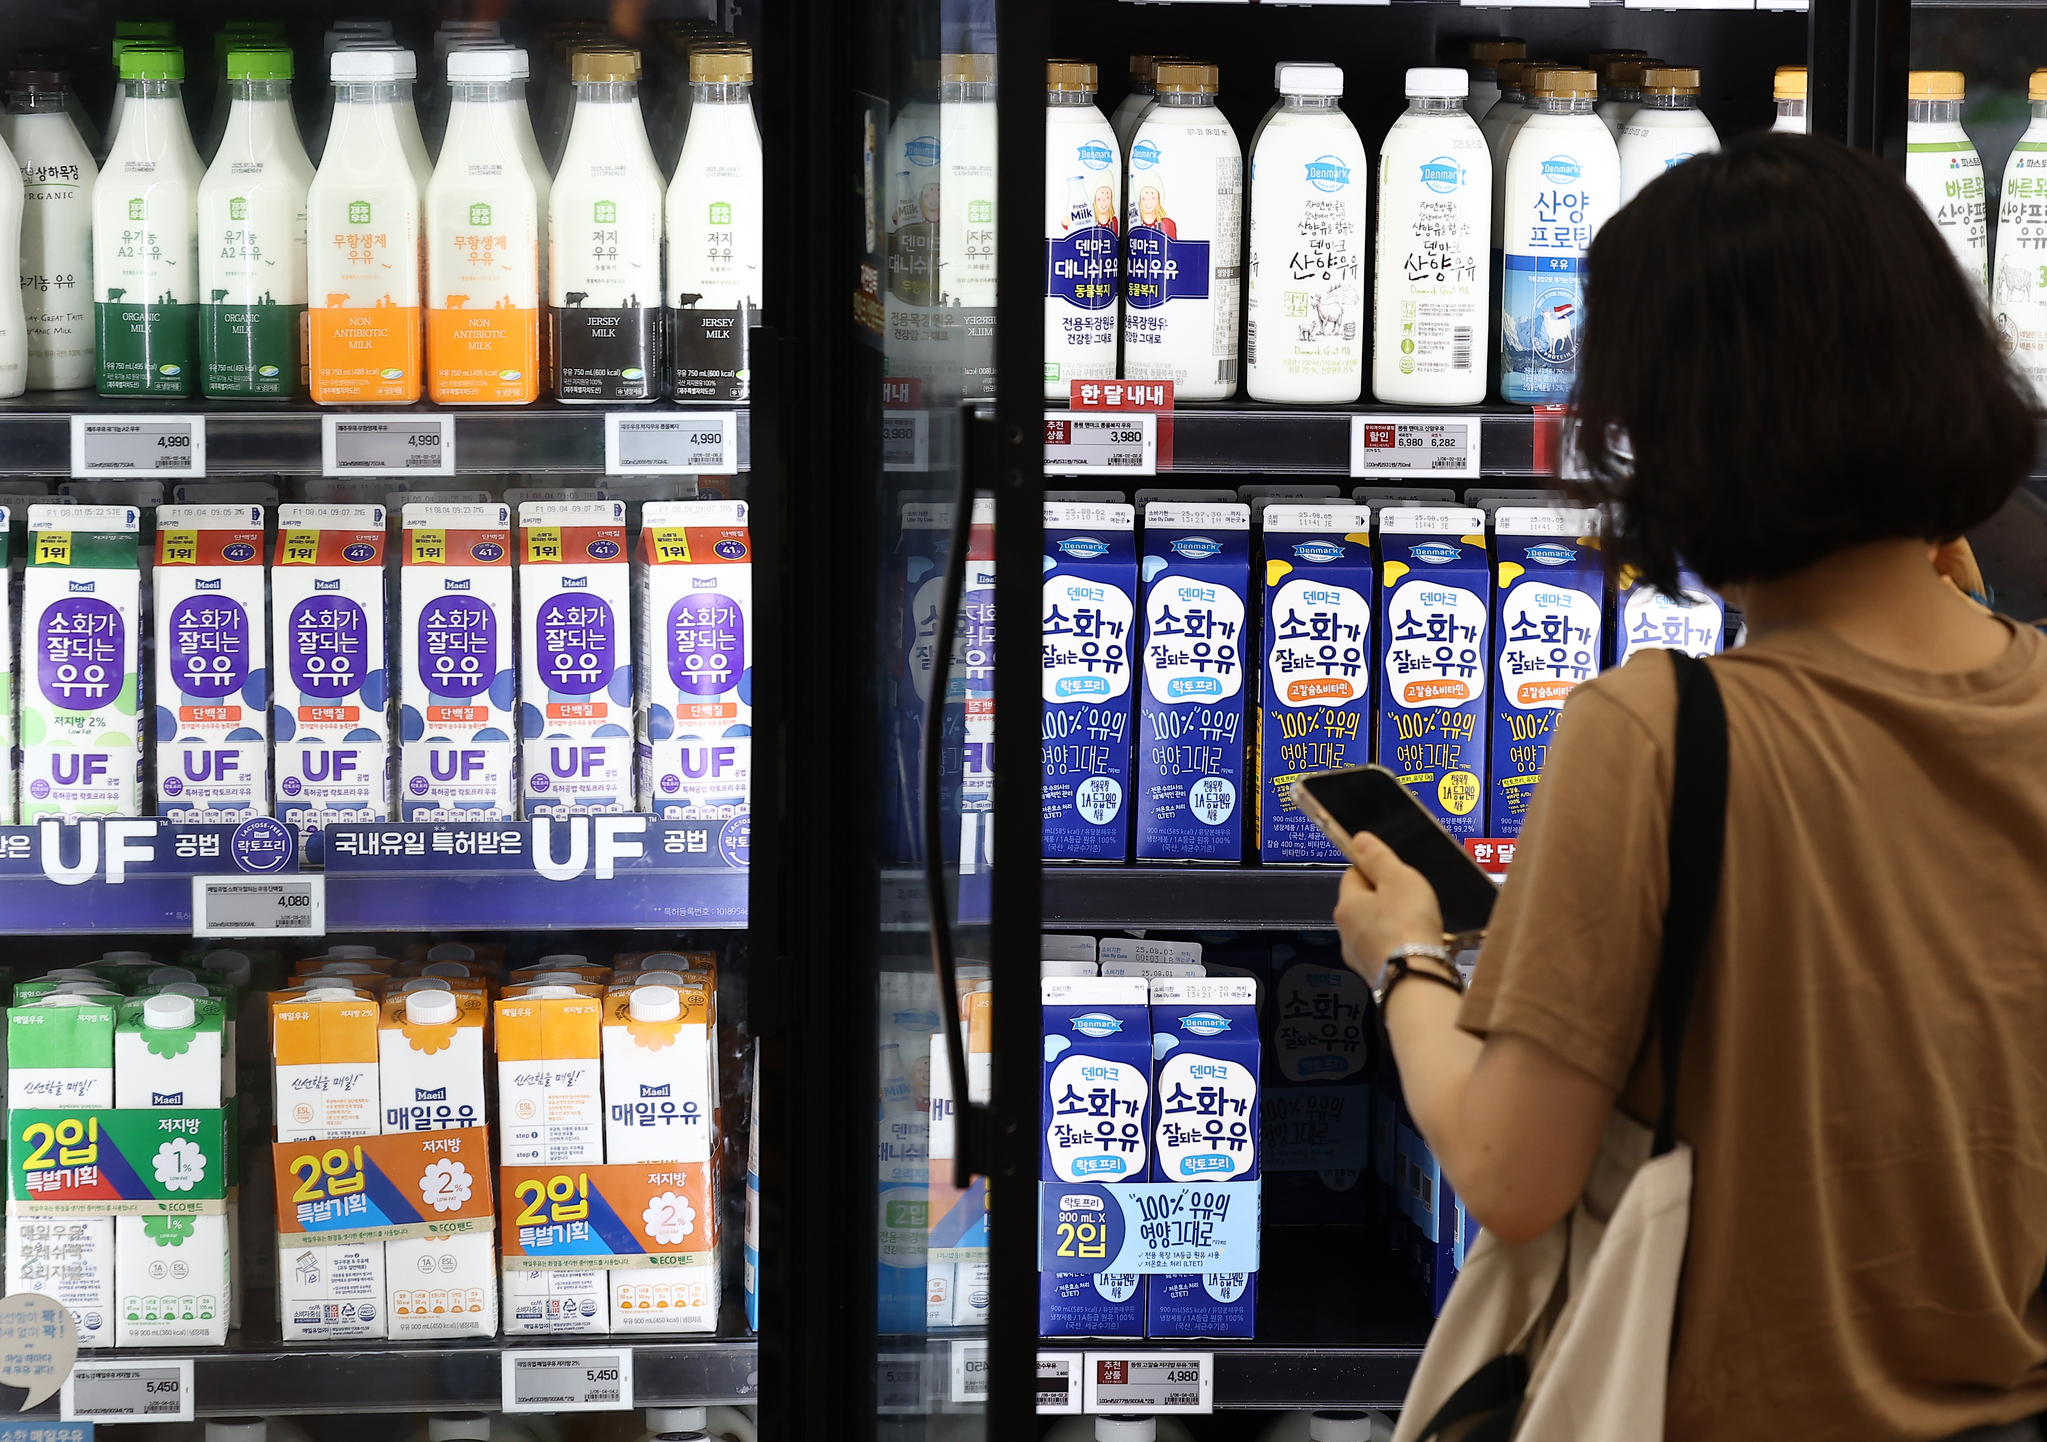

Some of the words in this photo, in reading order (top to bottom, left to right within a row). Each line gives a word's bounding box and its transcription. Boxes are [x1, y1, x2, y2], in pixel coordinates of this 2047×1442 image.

[1081, 150, 1111, 159] Denmark
[36, 165, 79, 181] 상하목장
[1310, 167, 1347, 178] Denmark
[1545, 163, 1579, 174] Denmark
[1533, 190, 1589, 224] 산양
[1071, 210, 1092, 222] Milk
[121, 230, 157, 244] 유기농
[334, 234, 386, 248] 무항생제
[454, 236, 507, 250] 무항생제
[593, 230, 618, 245] 저지
[708, 232, 732, 246] 저지
[118, 248, 133, 257] A2
[138, 247, 162, 260] 우유
[592, 247, 619, 261] 우유
[1076, 240, 1111, 256] 덴마크
[1310, 240, 1346, 255] 덴마크
[468, 252, 494, 266] 우유
[1289, 252, 1358, 280] 산양우유
[1550, 259, 1568, 270] 우유
[54, 275, 75, 288] 우유
[1075, 284, 1110, 297] 동물복지
[122, 313, 160, 321] ORGANIC
[468, 319, 490, 327] NON
[587, 317, 620, 326] JERSEY
[701, 319, 734, 327] JERSEY
[1062, 317, 1114, 332] 전용목장원유
[453, 330, 507, 338] ANTIBIOTIC
[1067, 333, 1092, 345] 건강함
[1094, 334, 1112, 344] 그대로
[468, 342, 492, 350] MILK
[563, 368, 573, 376] 우유
[606, 368, 620, 377] kcal)
[1081, 384, 1102, 405] 한
[1104, 384, 1123, 405] 달
[1127, 384, 1164, 406] 내내
[1047, 421, 1063, 430] 추천
[158, 436, 189, 448] 4,990
[408, 435, 440, 447] 4,990
[690, 433, 721, 445] 4,990
[1111, 432, 1141, 443] 3,980
[1370, 432, 1388, 442] 할인
[1399, 439, 1423, 447] 6,980
[1431, 439, 1455, 447] 6,282
[41, 547, 65, 558] 1위
[1178, 542, 1216, 550] Denmark
[71, 583, 94, 591] Maeil
[1179, 587, 1215, 602] 덴마크
[178, 609, 240, 630] 소화가
[297, 609, 359, 630] 소화가
[675, 606, 736, 628] 소화가
[1153, 605, 1235, 639] 소화가
[47, 613, 116, 637] 소화가
[1278, 608, 1360, 642] 소화가
[1510, 611, 1591, 644] 소화가
[178, 631, 240, 654] 잘되는
[297, 631, 358, 654] 잘되는
[675, 629, 736, 652] 잘되는
[47, 636, 116, 662] 잘되는
[183, 656, 236, 686] 우유
[302, 656, 355, 686] 우유
[680, 654, 732, 684] 우유
[52, 664, 110, 698] 우유
[1172, 679, 1217, 692] 락토프리
[194, 708, 226, 720] 단백질
[54, 716, 86, 727] 저지방
[89, 717, 106, 727] 2%
[52, 754, 108, 785] UF
[184, 750, 239, 781] UF
[41, 820, 158, 885] UF
[175, 834, 220, 857] 공법
[238, 839, 285, 853] 락토프리
[335, 832, 425, 856] 국내유일
[431, 832, 522, 855] 특허받은
[530, 815, 648, 881] UF
[664, 830, 707, 853] 공법
[1474, 843, 1493, 863] 한
[278, 896, 309, 908] 4,080
[1135, 947, 1174, 956] 25.08.03
[1284, 990, 1361, 1021] 소화가
[13, 1015, 44, 1024] 매일우유
[340, 1010, 359, 1018] 저지방
[361, 1009, 374, 1017] 2%
[24, 1081, 64, 1095] 신선함을
[642, 1087, 669, 1096] Maeil
[154, 1096, 181, 1105] Maeil
[1057, 1084, 1139, 1117] 소화가
[387, 1105, 478, 1131] 매일우유
[612, 1101, 701, 1127] 매일우유
[158, 1119, 201, 1134] 저지방
[21, 1117, 99, 1170] 2입
[422, 1138, 462, 1153] 저지방
[25, 1168, 98, 1192] 특별기획
[289, 1145, 364, 1203] 2입
[515, 1172, 588, 1226] 2입
[1064, 1198, 1099, 1208] 락토프리
[168, 1203, 185, 1211] ECO
[187, 1203, 203, 1211] 밴드
[296, 1192, 367, 1224] 특별기획
[1190, 1192, 1230, 1222] 우유의
[1059, 1213, 1077, 1222] 900
[1081, 1213, 1095, 1222] mL
[1098, 1213, 1105, 1222] X
[1056, 1223, 1106, 1258] 2입
[1104, 1361, 1121, 1370] 추천
[587, 1370, 618, 1382] 5,450
[1104, 1371, 1121, 1379] 상품
[1168, 1371, 1198, 1383] 4,980
[146, 1381, 178, 1394] 5,450
